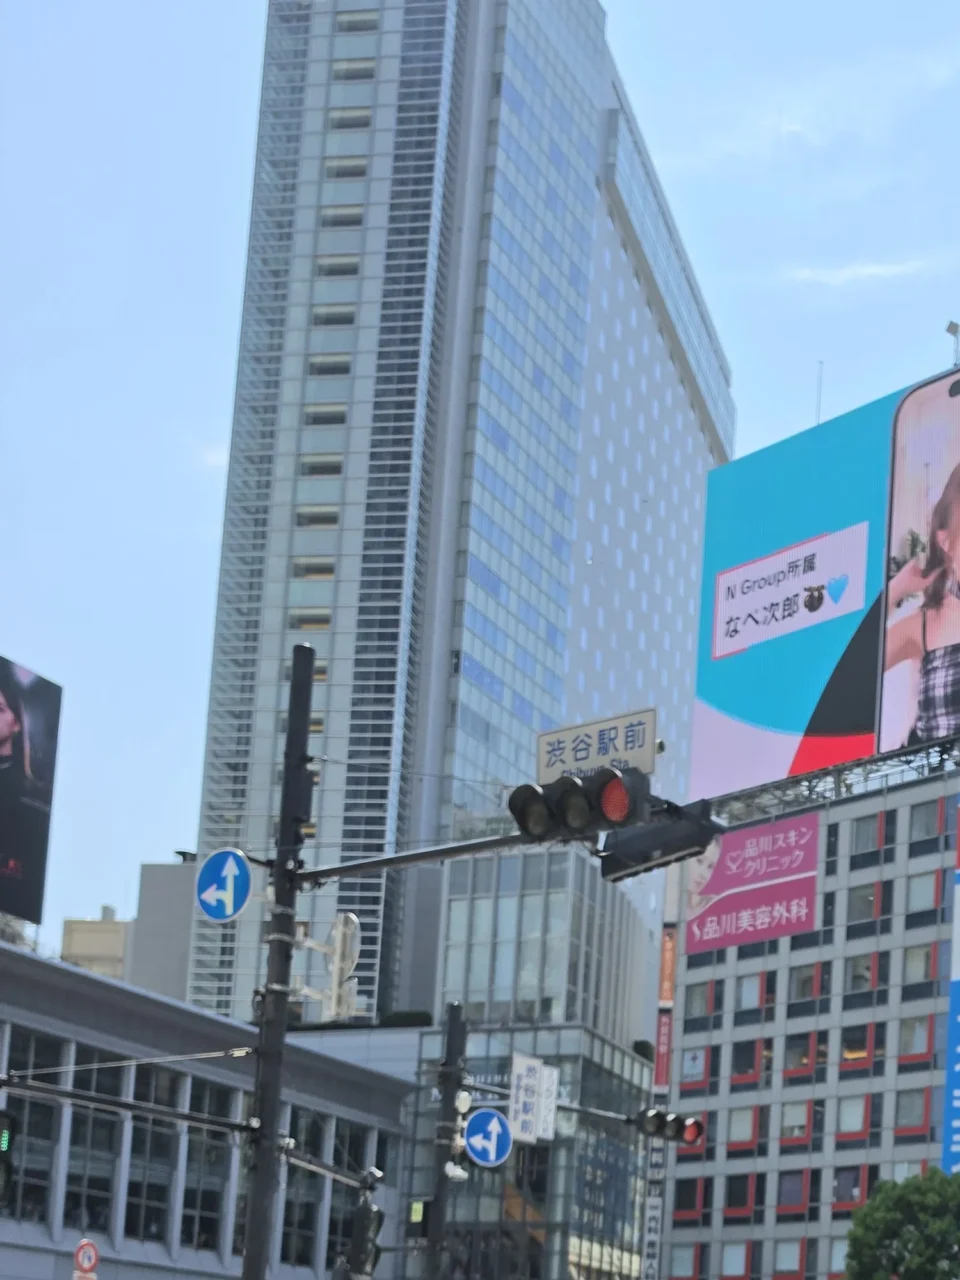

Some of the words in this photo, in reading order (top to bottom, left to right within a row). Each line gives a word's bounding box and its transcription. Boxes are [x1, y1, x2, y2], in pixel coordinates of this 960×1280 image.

[545, 720, 646, 768] 渋谷駅前
[743, 827, 814, 858] 品川スキン
[743, 849, 805, 879] クリニック
[702, 897, 809, 941] 品川美容外科
